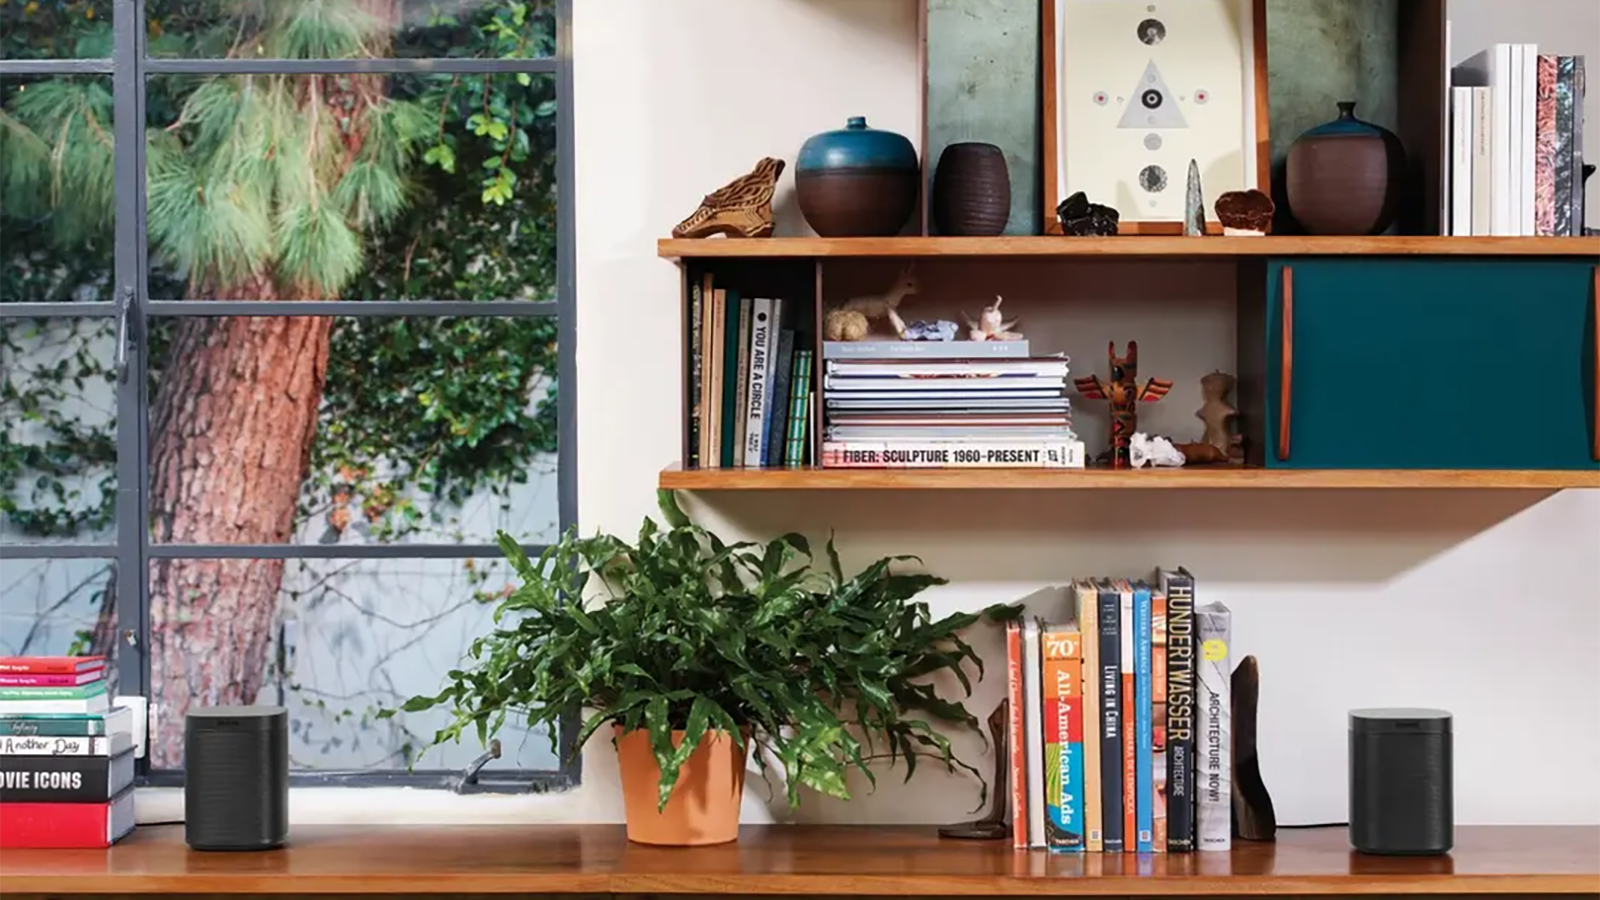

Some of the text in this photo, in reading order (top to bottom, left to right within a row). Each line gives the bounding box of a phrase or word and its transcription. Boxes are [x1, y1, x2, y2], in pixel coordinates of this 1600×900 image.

[754, 326, 767, 348] YOU
[752, 350, 765, 370] ARE
[752, 372, 763, 381] A
[750, 382, 763, 420] CIRCLE
[843, 449, 880, 464] FIBER:
[882, 449, 948, 464] SCULPTURE
[1104, 665, 1118, 696] LIVING
[1167, 586, 1192, 797] HUNDERTWASSER ARCHITECTURE
[1056, 669, 1072, 786] All-American
[1105, 710, 1120, 739] CHINA
[5, 738, 80, 756] Another Day
[1125, 720, 1134, 760] TAMARA
[1208, 691, 1221, 803] ARCHITECTURE NOW!
[34, 771, 82, 789] ICONS
[1060, 788, 1074, 825] Ads
